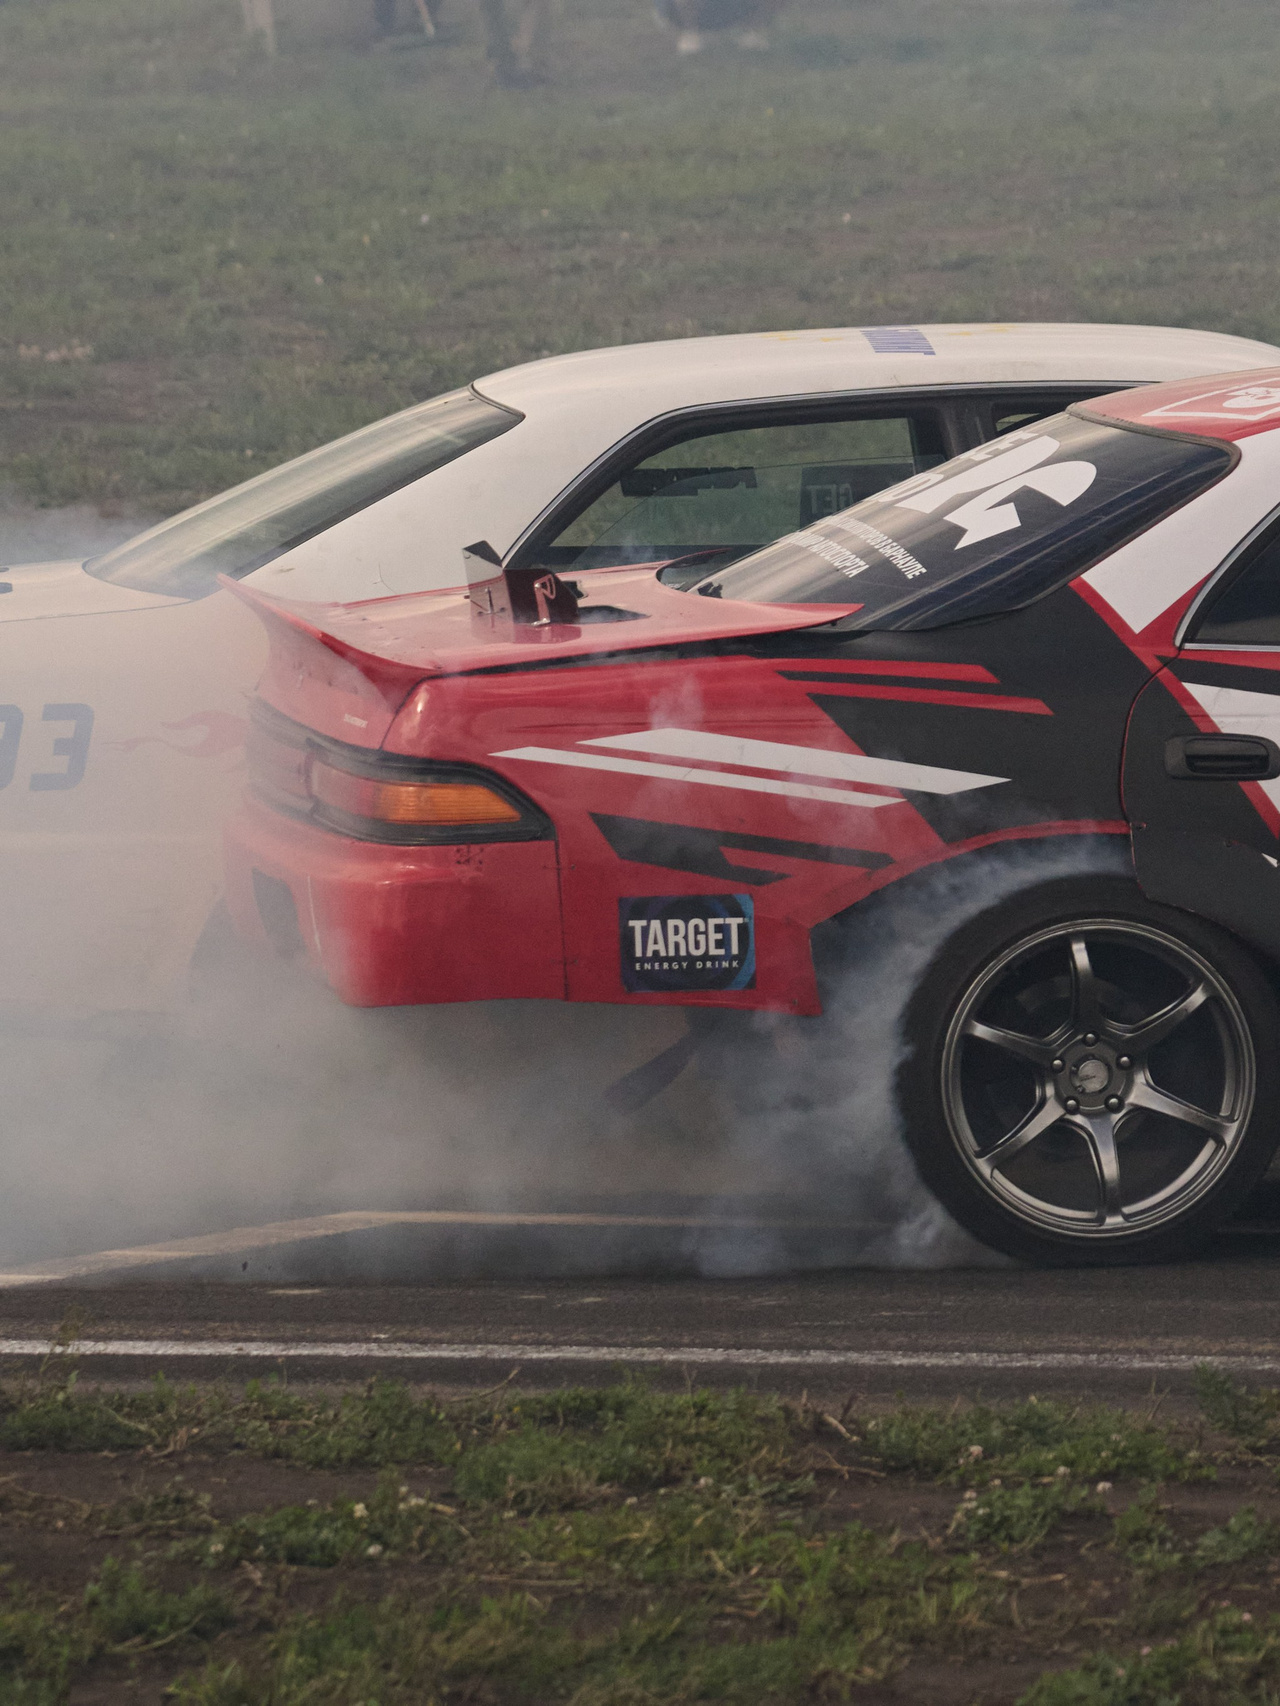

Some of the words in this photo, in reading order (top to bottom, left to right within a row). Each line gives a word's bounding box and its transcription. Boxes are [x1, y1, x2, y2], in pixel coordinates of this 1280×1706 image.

[807, 538, 870, 578] АВТОСПОРТА
[878, 541, 927, 580] БАРНАУЛЕ
[628, 917, 745, 958] TARGET
[635, 961, 689, 971] ENERGY
[696, 960, 740, 969] DRINK
